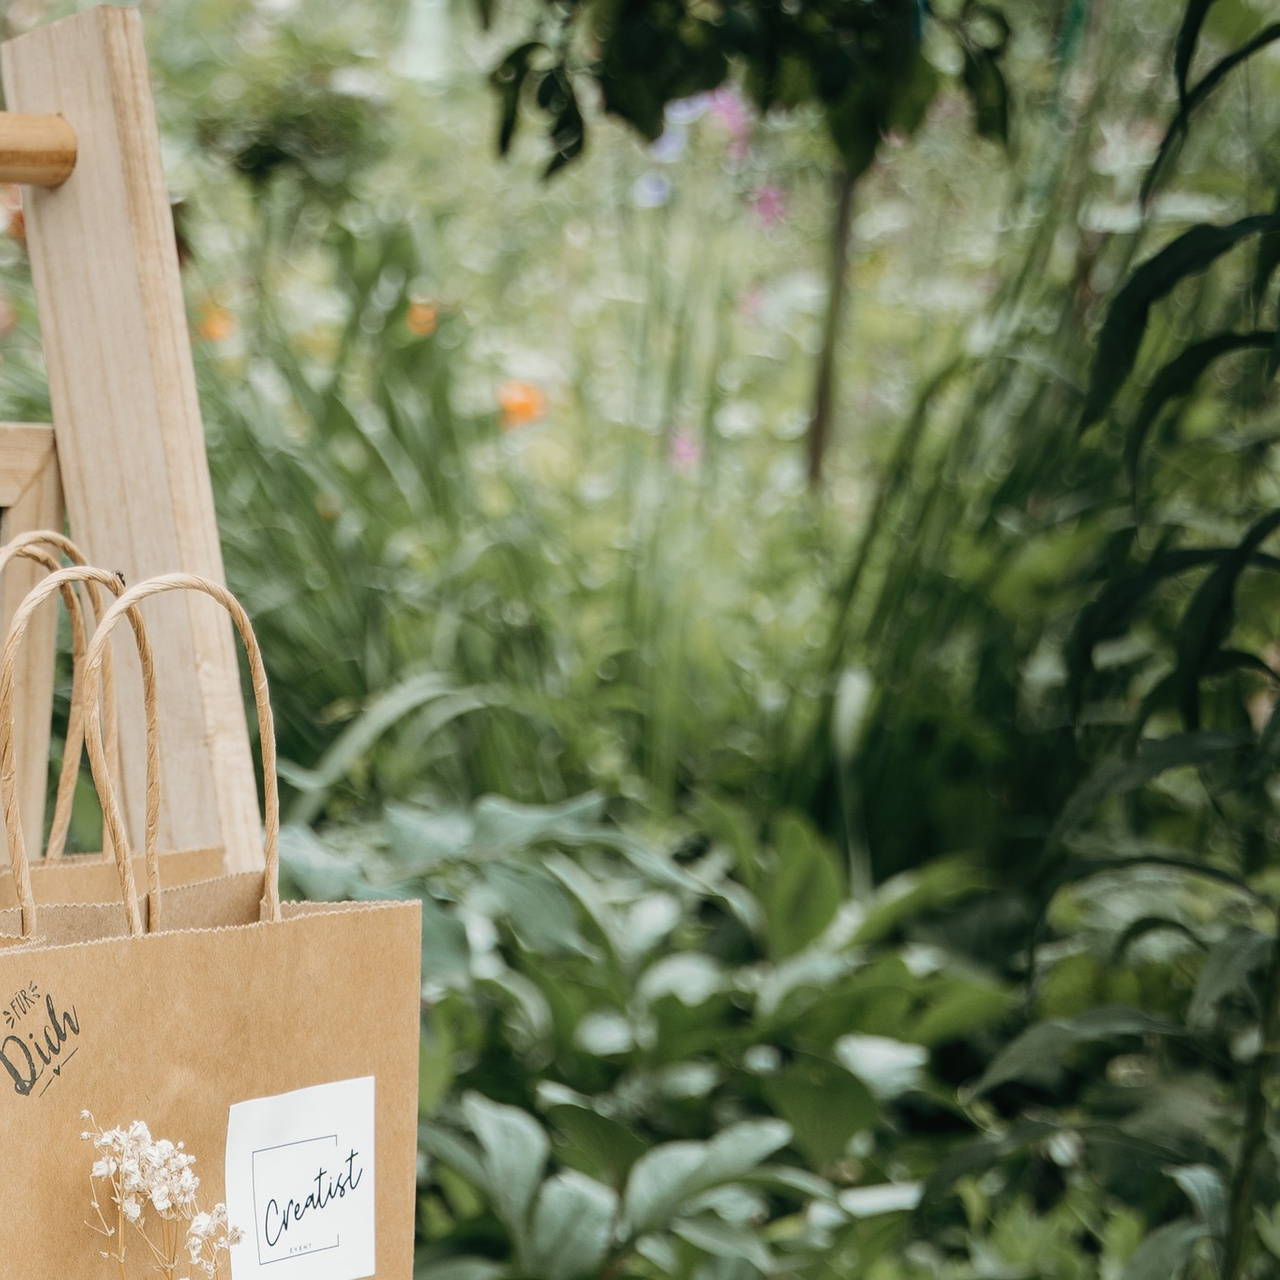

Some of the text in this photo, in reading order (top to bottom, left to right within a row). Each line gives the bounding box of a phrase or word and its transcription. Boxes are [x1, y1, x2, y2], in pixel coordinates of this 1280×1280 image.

[10, 988, 36, 1022] FÜR
[265, 1148, 363, 1247] Creatist
[289, 1242, 313, 1255] EVENT
